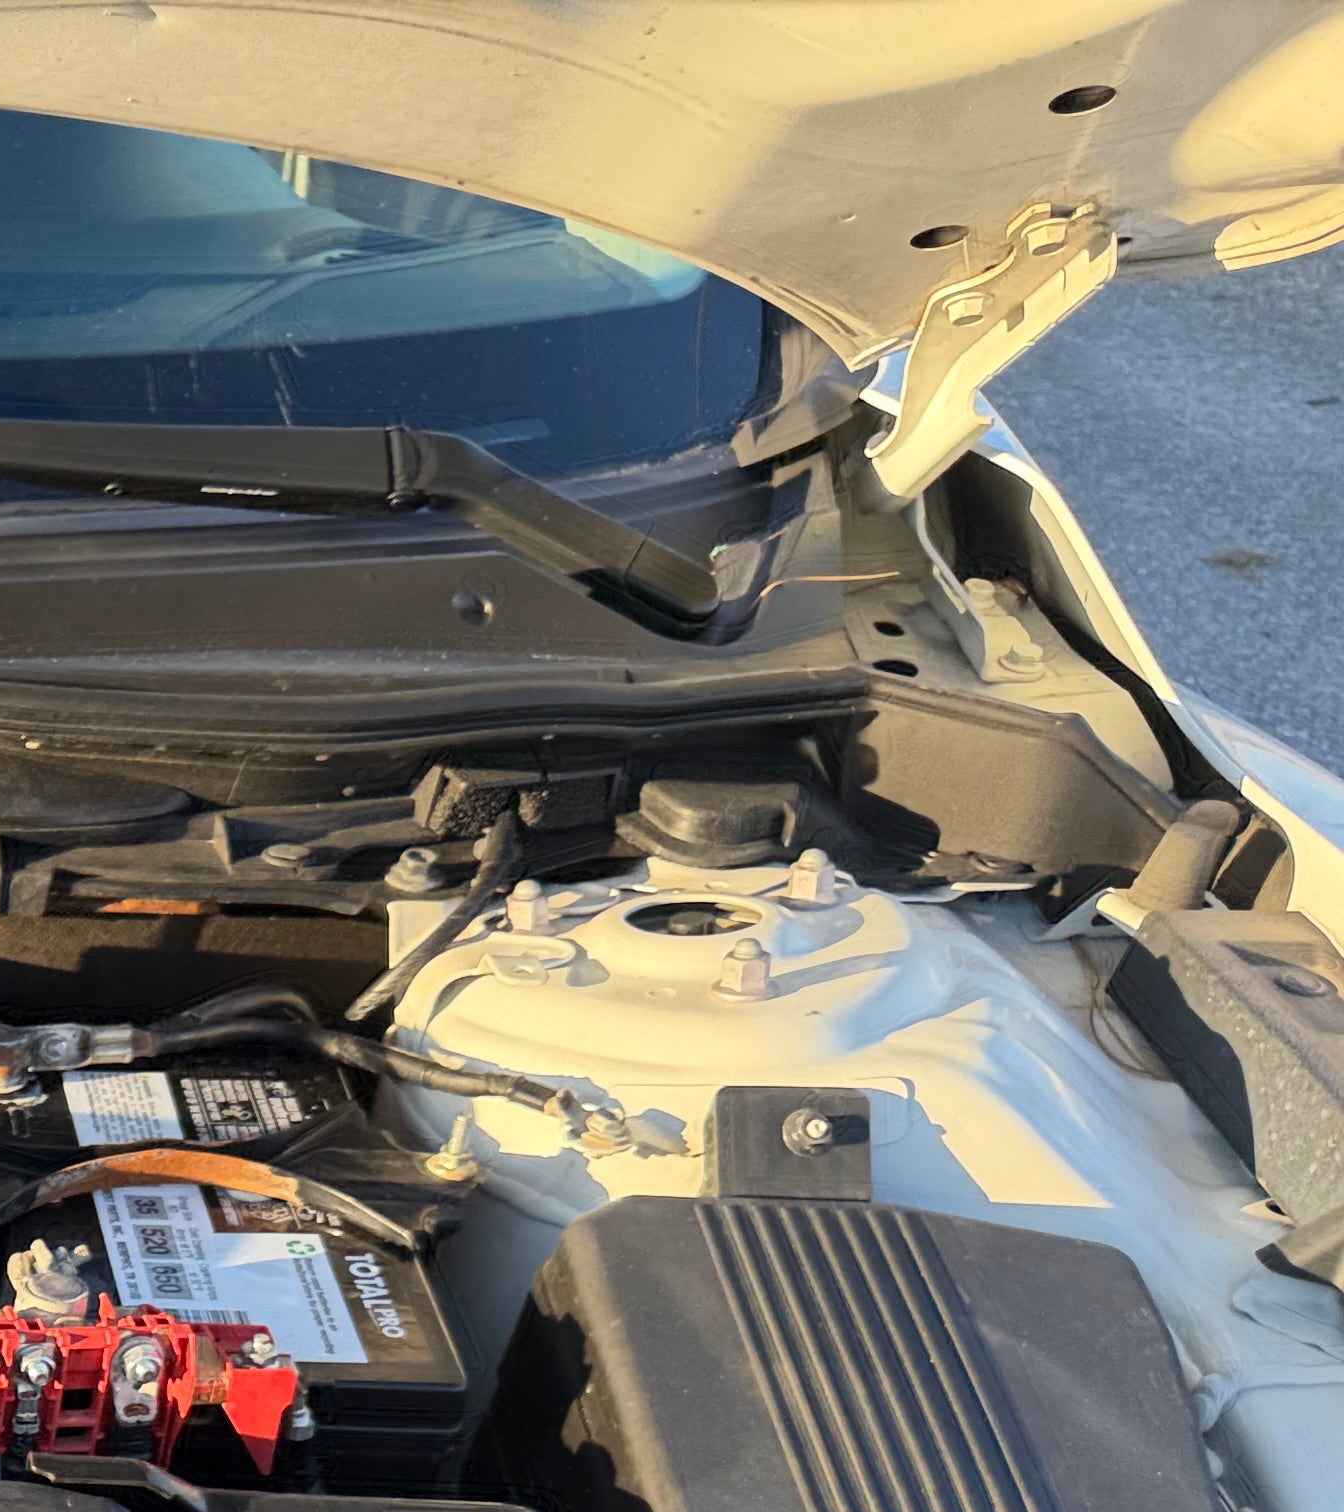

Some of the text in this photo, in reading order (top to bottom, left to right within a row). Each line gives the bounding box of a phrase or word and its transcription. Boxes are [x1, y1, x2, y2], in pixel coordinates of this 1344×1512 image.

[134, 1199, 159, 1215] 35
[140, 1228, 170, 1255] 520
[153, 1266, 182, 1293] 650
